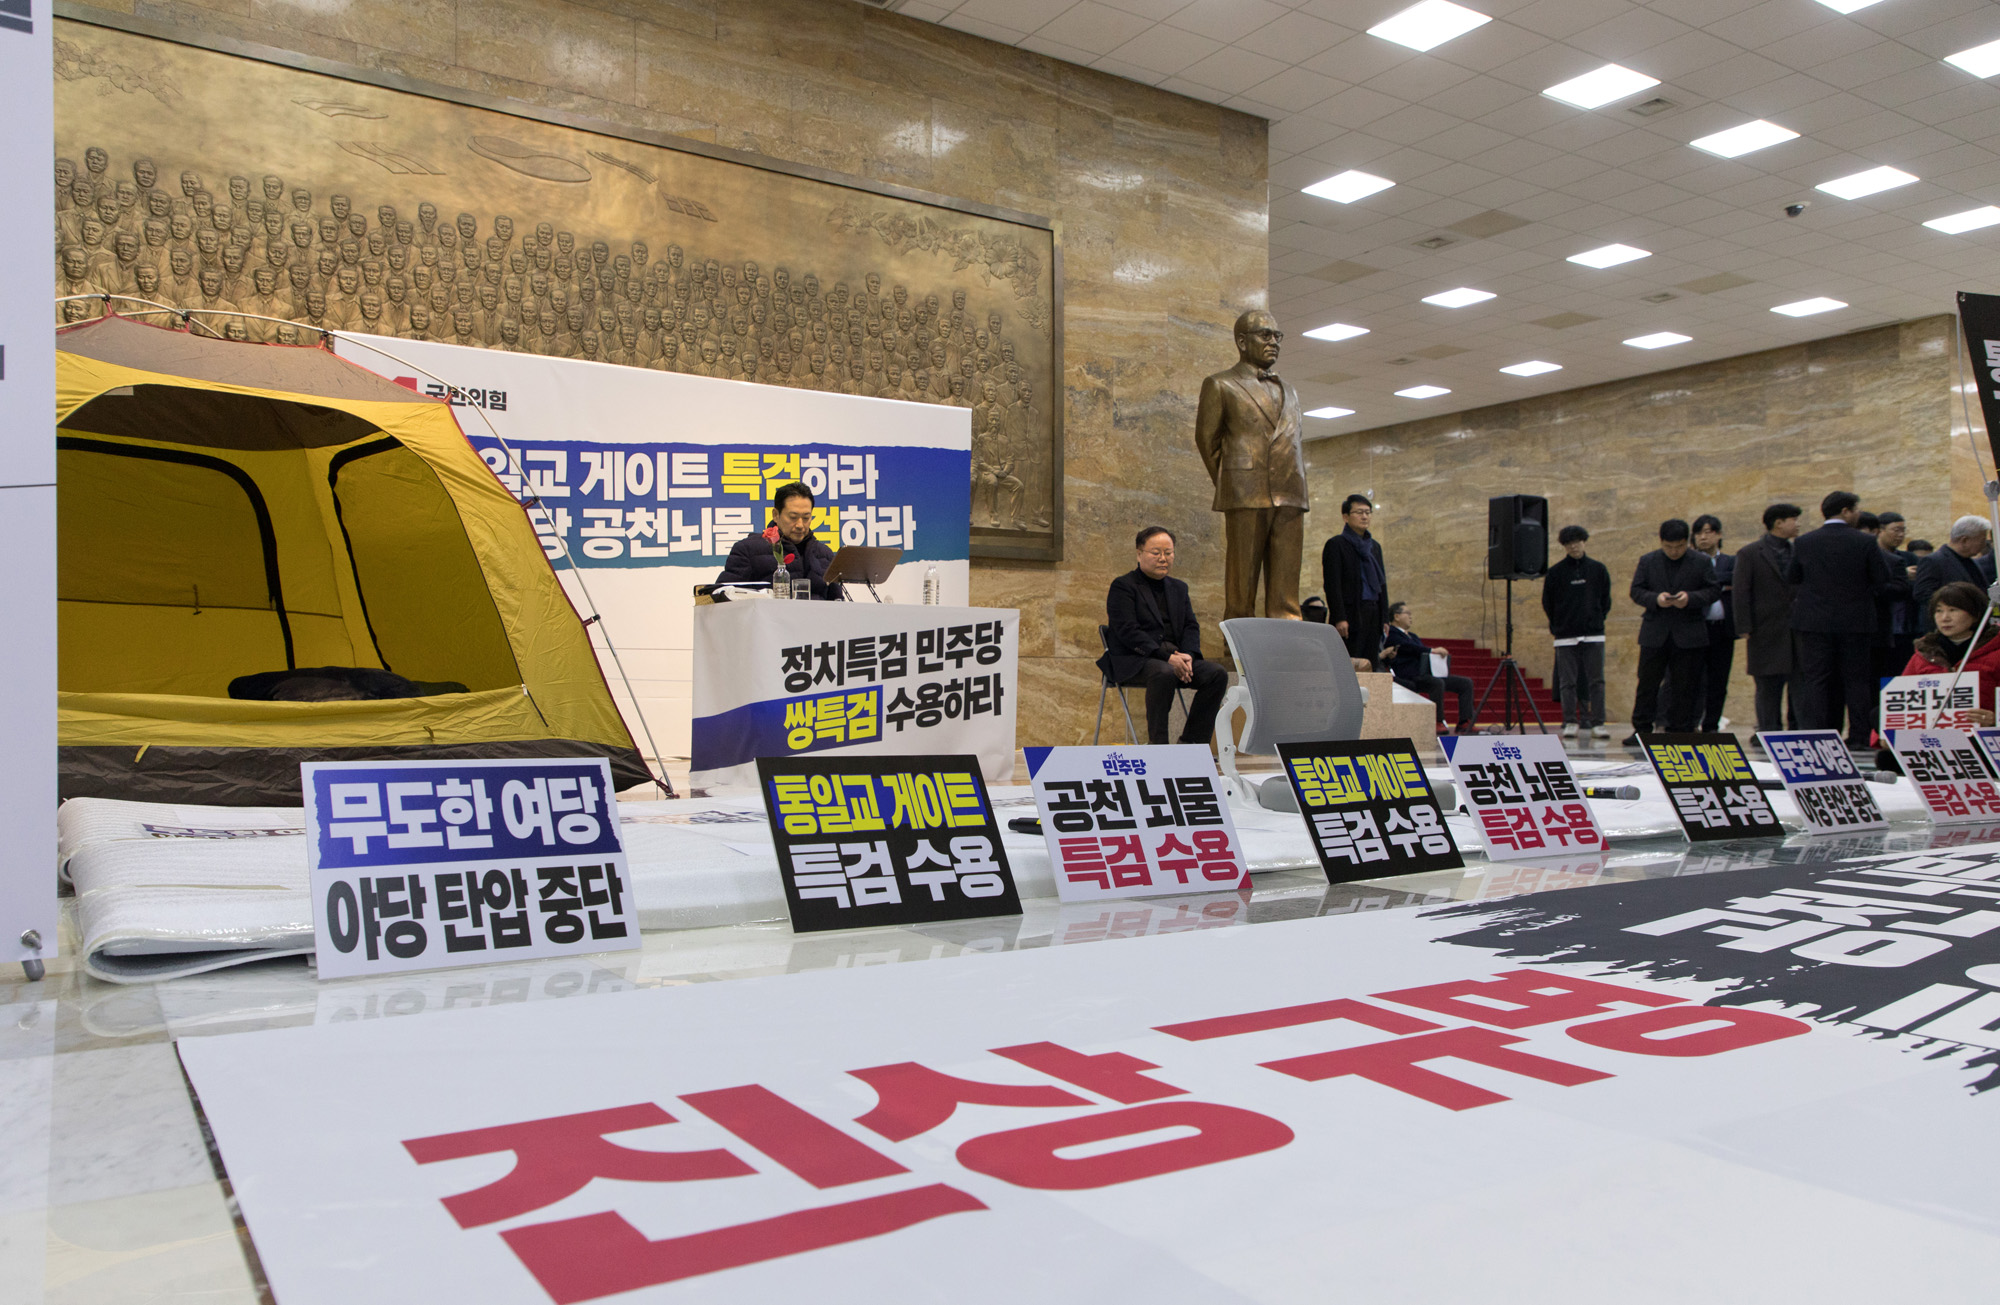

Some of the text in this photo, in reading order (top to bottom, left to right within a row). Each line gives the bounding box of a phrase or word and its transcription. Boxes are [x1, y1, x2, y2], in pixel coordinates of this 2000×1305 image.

[579, 450, 712, 501] 게이트
[720, 452, 879, 501] 특검하라
[580, 506, 754, 560] 공천뇌물
[765, 505, 917, 552] 검하라
[781, 620, 1004, 693] 정치특검 민주당
[783, 672, 1004, 750] 쌍특검 수용하라
[1885, 689, 1927, 712] 공천
[1102, 759, 1146, 776] 민주당
[1290, 752, 1429, 807] 통일교 게이트
[1492, 746, 1522, 760] 민주당
[1649, 744, 1709, 782] 통일교
[1695, 744, 1753, 781] 게이트
[1770, 739, 1854, 778] 무도한 여당
[1900, 749, 1951, 782] 공천
[1939, 748, 1988, 780] 뇌물
[774, 772, 986, 835] 통일교 게이트
[1043, 776, 1223, 833] 공천 뇌물
[1458, 761, 1582, 805] 공천 뇌물
[1670, 784, 1775, 829] 특검 수용
[1794, 783, 1884, 827] 야당 탄압 중단
[1920, 781, 2000, 817] 특검 수용
[329, 776, 600, 855] 무도한 여당
[1311, 803, 1451, 865] 특검 수용
[1478, 803, 1600, 851] 특검 수용
[788, 835, 1005, 909] 특검 수용
[1058, 829, 1239, 890] 특검 수용
[327, 862, 628, 961] 야당 탄압 중단
[403, 1042, 1294, 1305] 진상
[1153, 969, 1811, 1110] 규명
